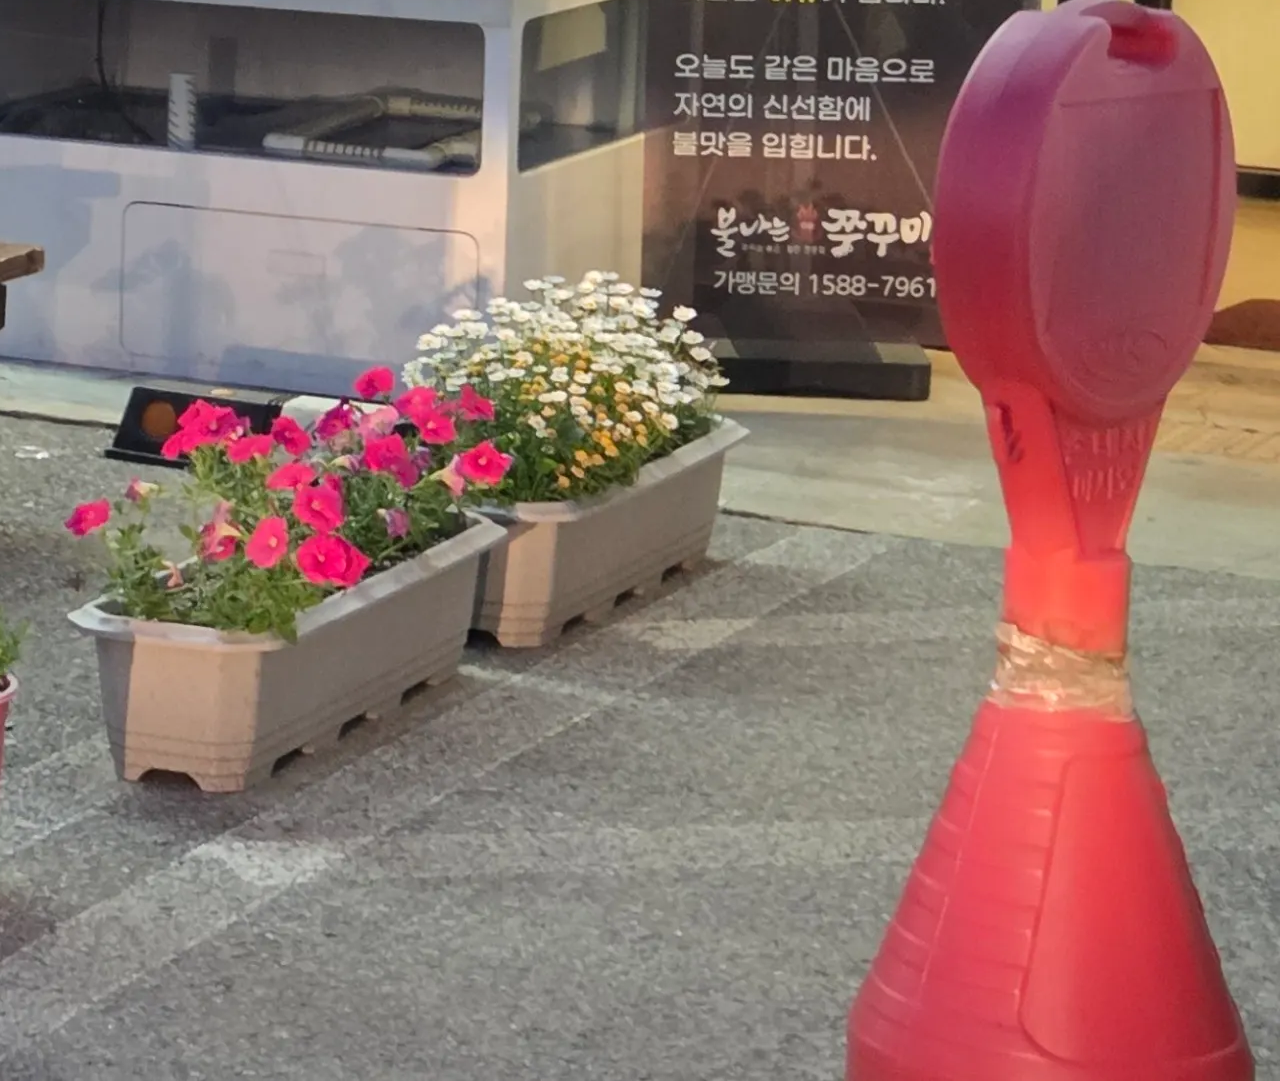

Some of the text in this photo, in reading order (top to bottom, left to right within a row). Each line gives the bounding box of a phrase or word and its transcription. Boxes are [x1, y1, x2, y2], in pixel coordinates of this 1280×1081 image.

[674, 53, 935, 83] 오늘도 같은 마음으로
[673, 93, 870, 122] 자연의 신선함에
[672, 131, 877, 161] 불맛을 입힙니다.
[714, 271, 936, 297] 가맹문의 1588-7961
